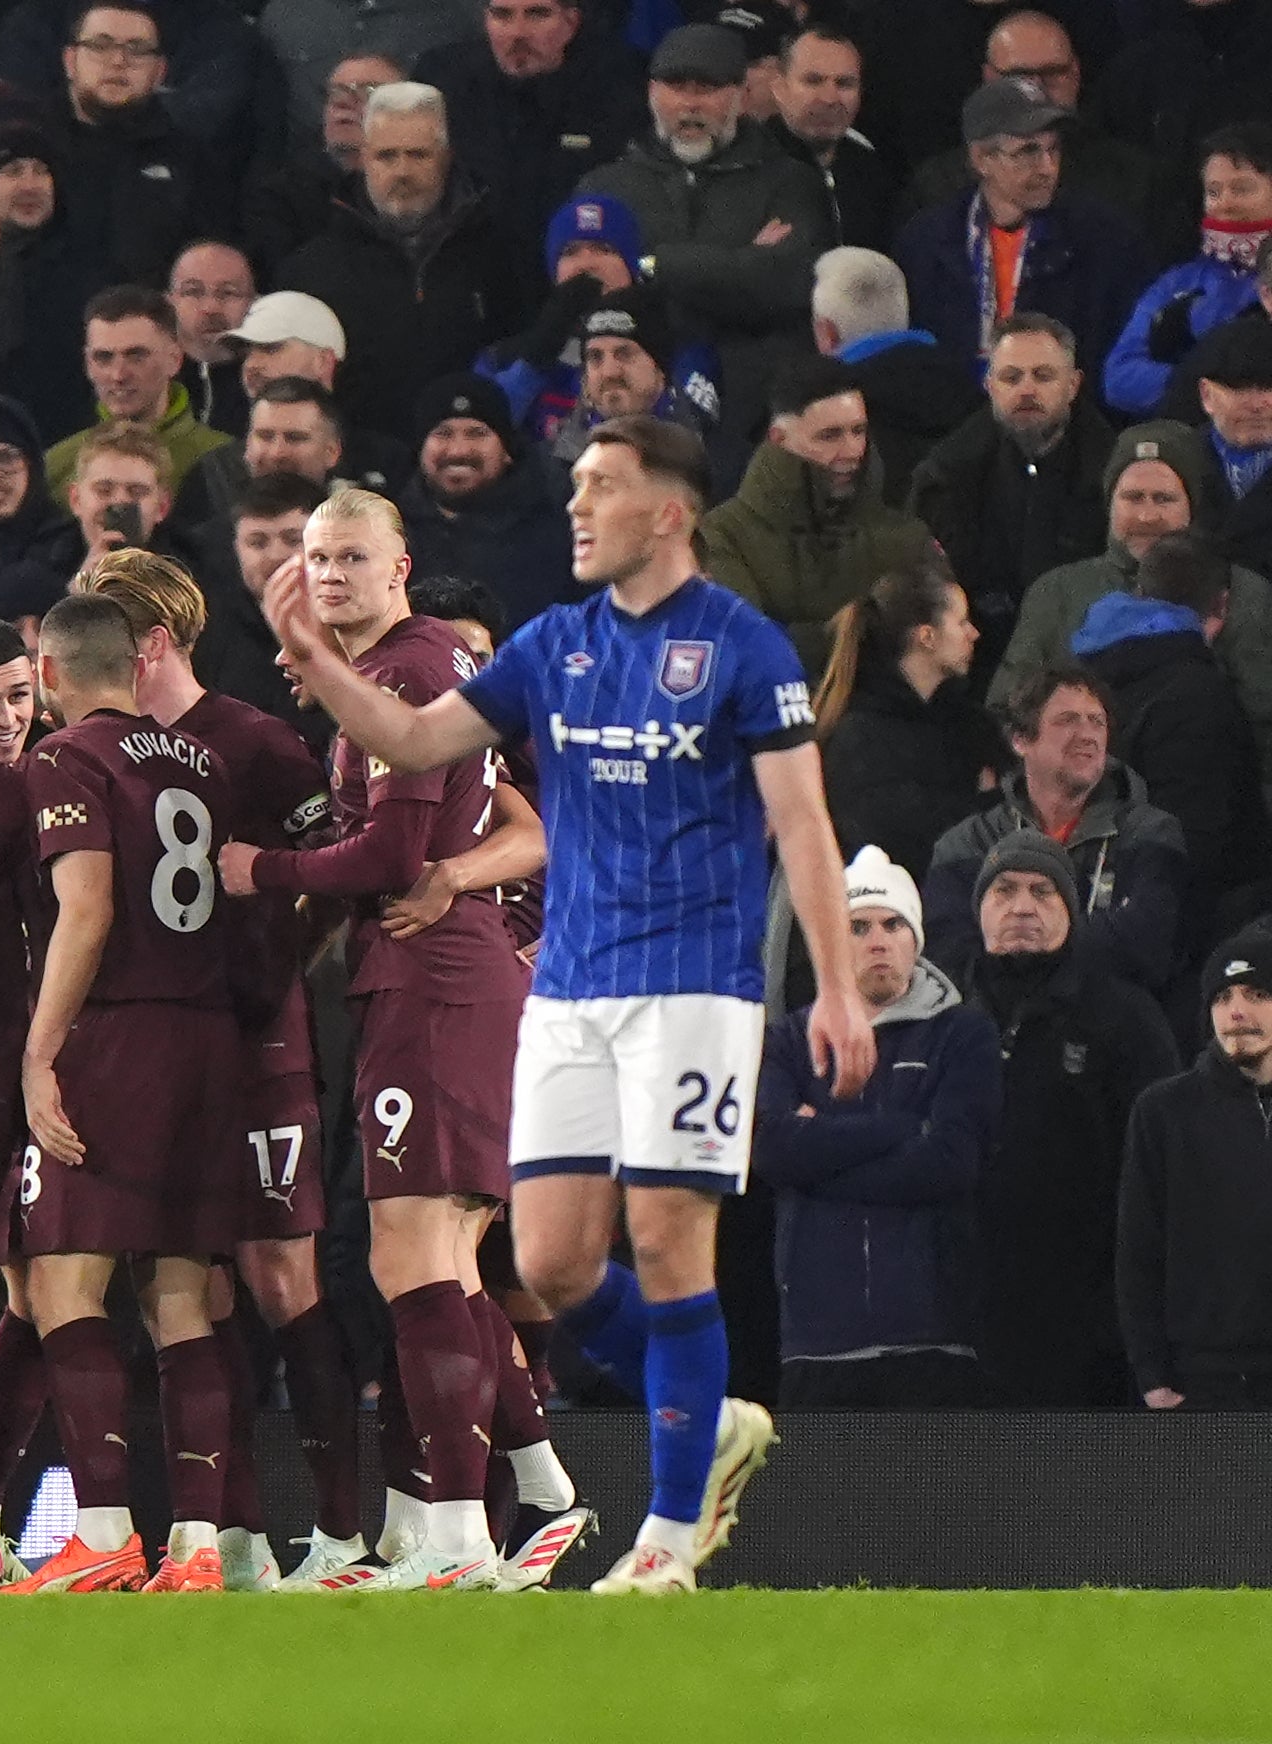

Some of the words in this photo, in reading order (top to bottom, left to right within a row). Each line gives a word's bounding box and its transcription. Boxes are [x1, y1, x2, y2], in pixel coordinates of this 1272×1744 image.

[589, 757, 649, 785] TOUR
[151, 787, 216, 933] 8
[374, 1087, 414, 1147] 9
[673, 1071, 739, 1137] 26
[247, 1125, 303, 1188] 17
